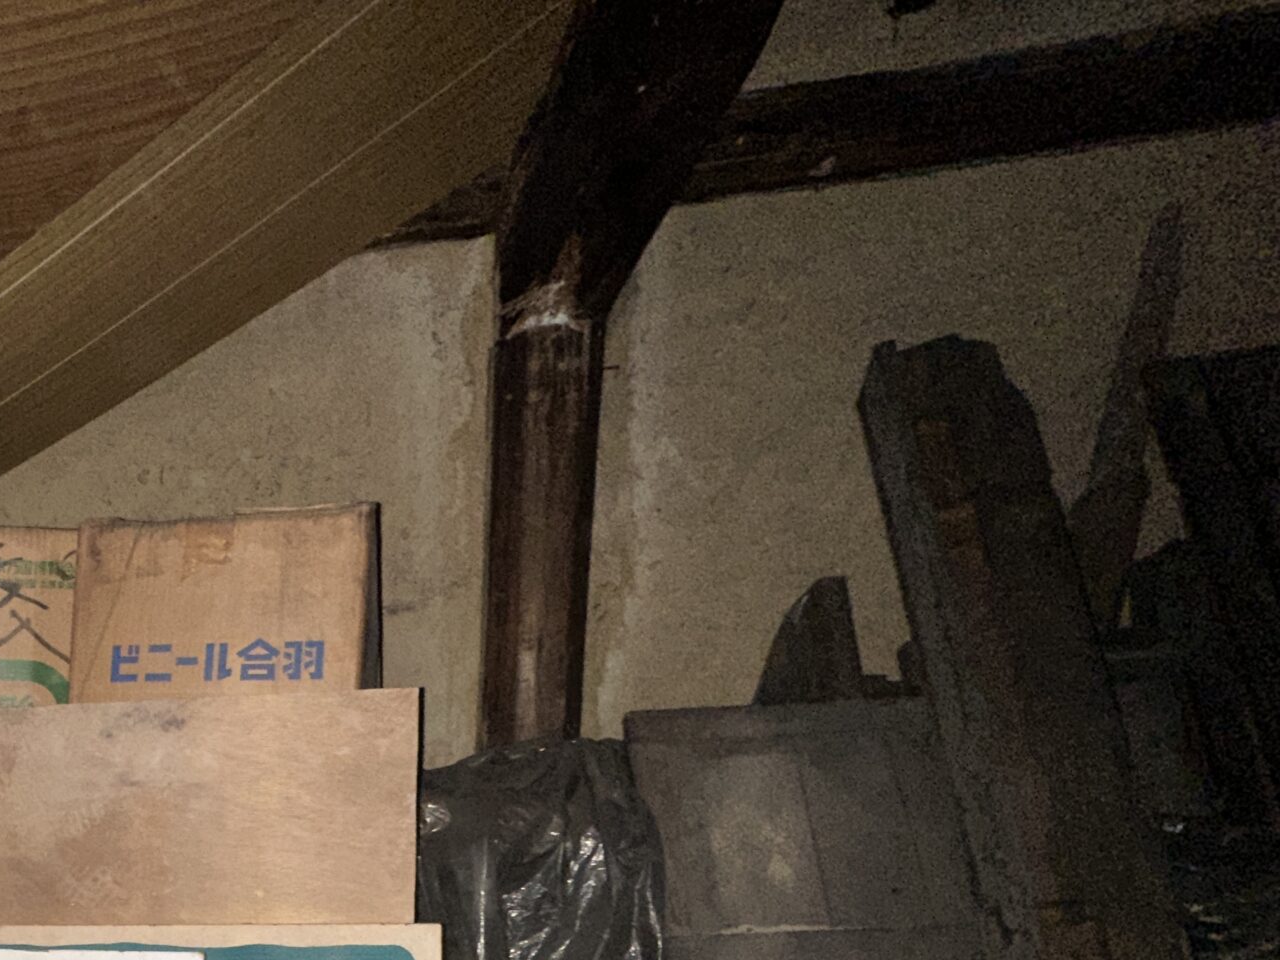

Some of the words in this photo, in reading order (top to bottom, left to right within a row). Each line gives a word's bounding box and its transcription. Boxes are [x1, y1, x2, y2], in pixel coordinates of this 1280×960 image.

[110, 638, 325, 683] ビニール合羽
